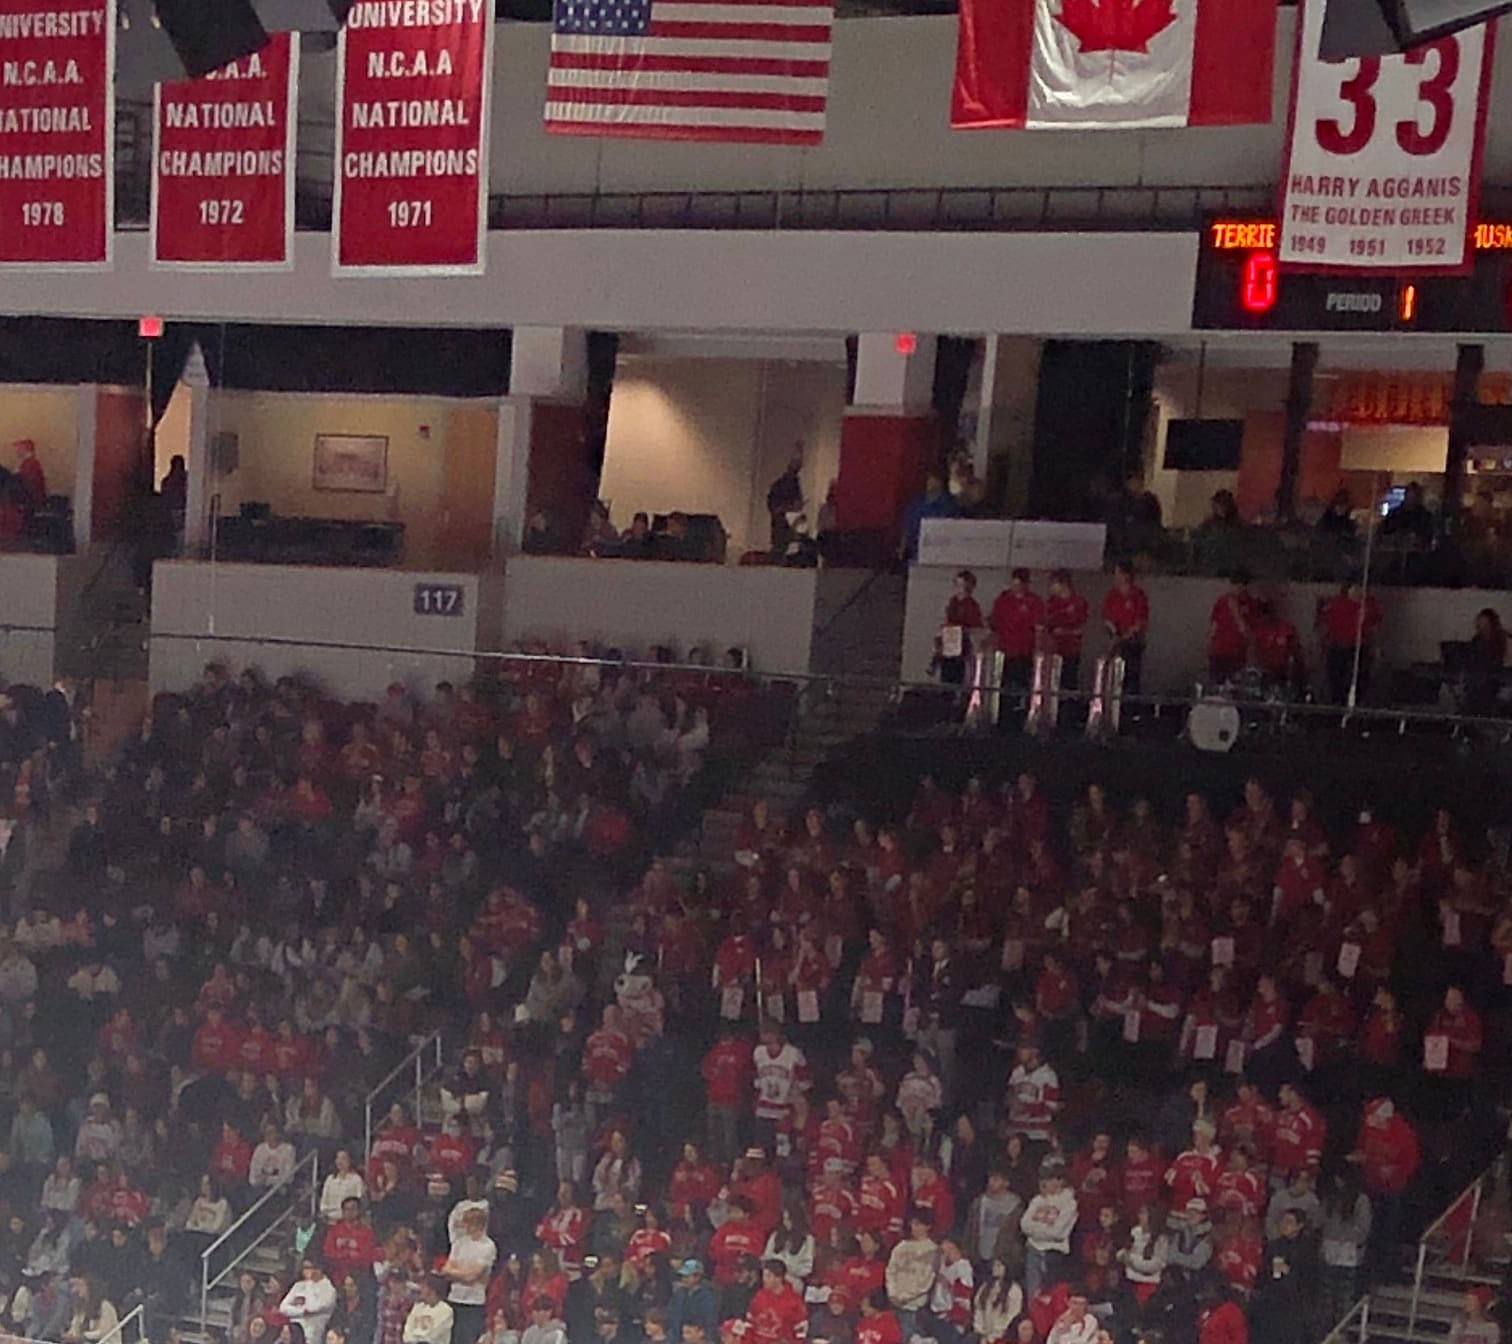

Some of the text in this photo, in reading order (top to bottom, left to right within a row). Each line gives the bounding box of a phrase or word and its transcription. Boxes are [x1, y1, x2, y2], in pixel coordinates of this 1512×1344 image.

[348, 0, 482, 29] UNIVERSITY
[3, 60, 84, 86] N.C.A.A.
[1316, 36, 1460, 155] 33
[166, 101, 275, 129] NATIONAL
[352, 100, 469, 129] NATIONAL
[160, 150, 282, 176] CHAMPIONS
[345, 149, 478, 179] CHAMPIONS
[1291, 175, 1461, 198] HARRY AGGANIS
[22, 202, 64, 226] 1978
[199, 200, 244, 225] 1972
[388, 200, 432, 227] 1971
[1291, 204, 1456, 226] THE GOLDEN GREEK
[1326, 293, 1382, 312] PERIOD
[420, 590, 457, 611] 117
